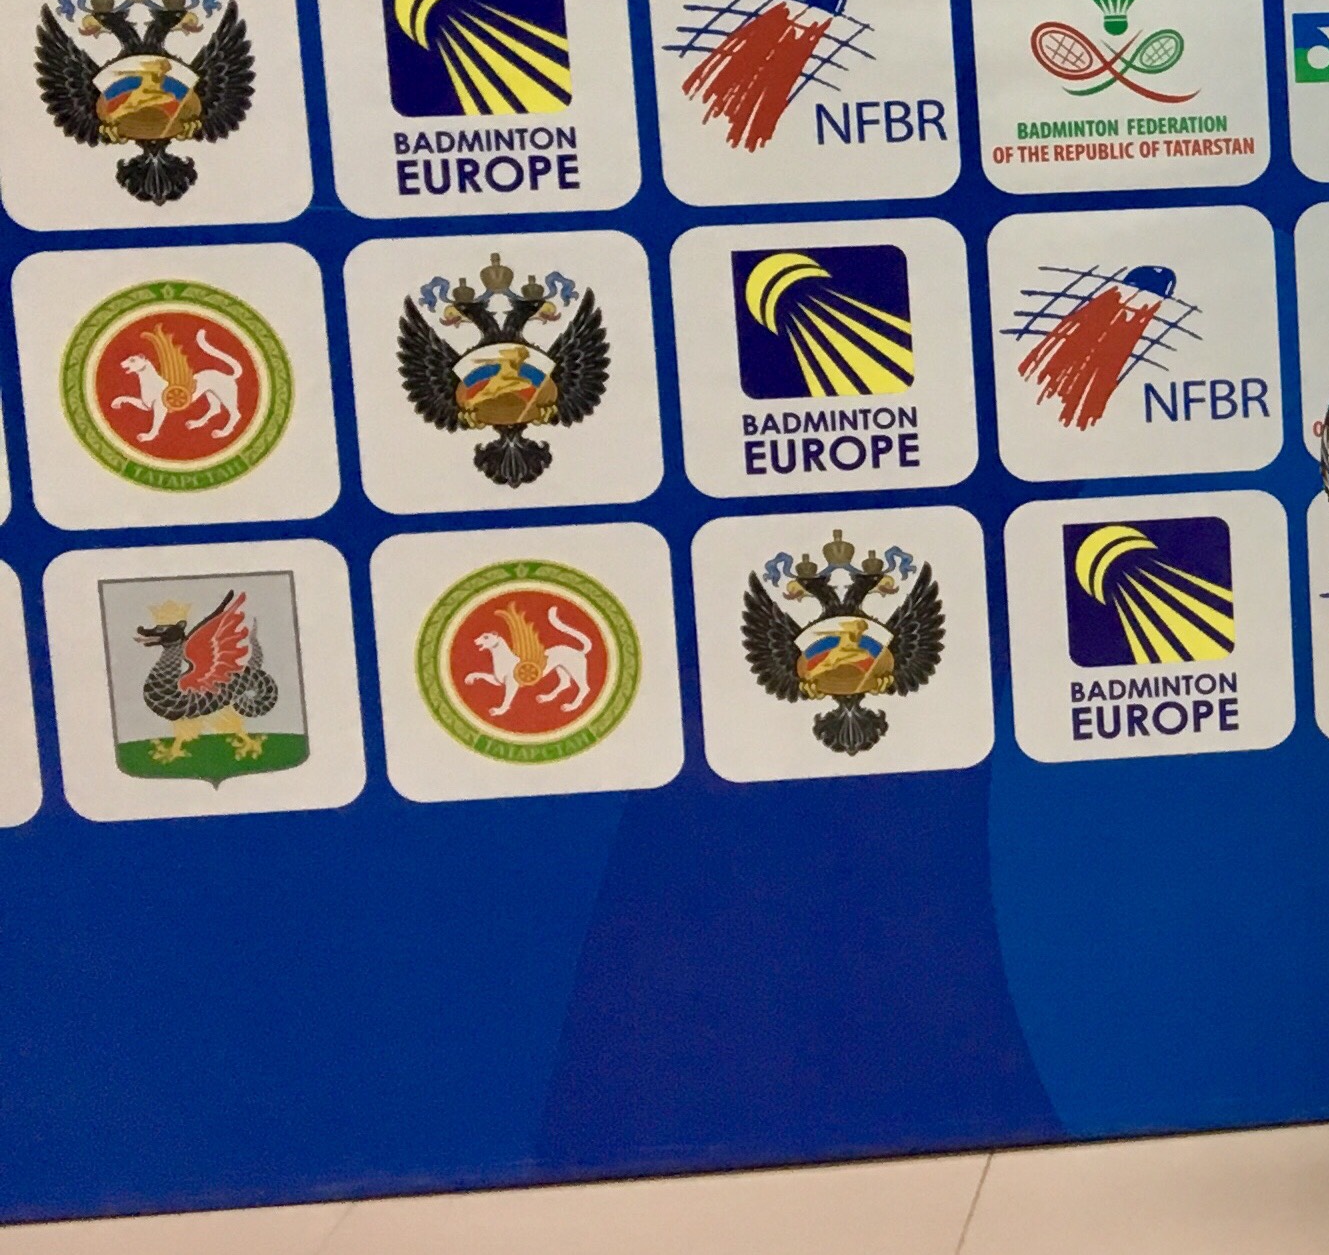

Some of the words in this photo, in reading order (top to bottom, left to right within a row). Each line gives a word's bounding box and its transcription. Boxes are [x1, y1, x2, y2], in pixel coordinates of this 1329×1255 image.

[393, 126, 577, 155] BADMINTON
[814, 97, 947, 144] NFBR
[396, 153, 580, 196] EUROPE
[1144, 374, 1270, 421] NFBR
[741, 407, 916, 436] BADMINTON
[743, 432, 918, 476] EUROPE
[1069, 672, 1236, 703] BADMINTON
[1070, 697, 1238, 741] EUROPE
